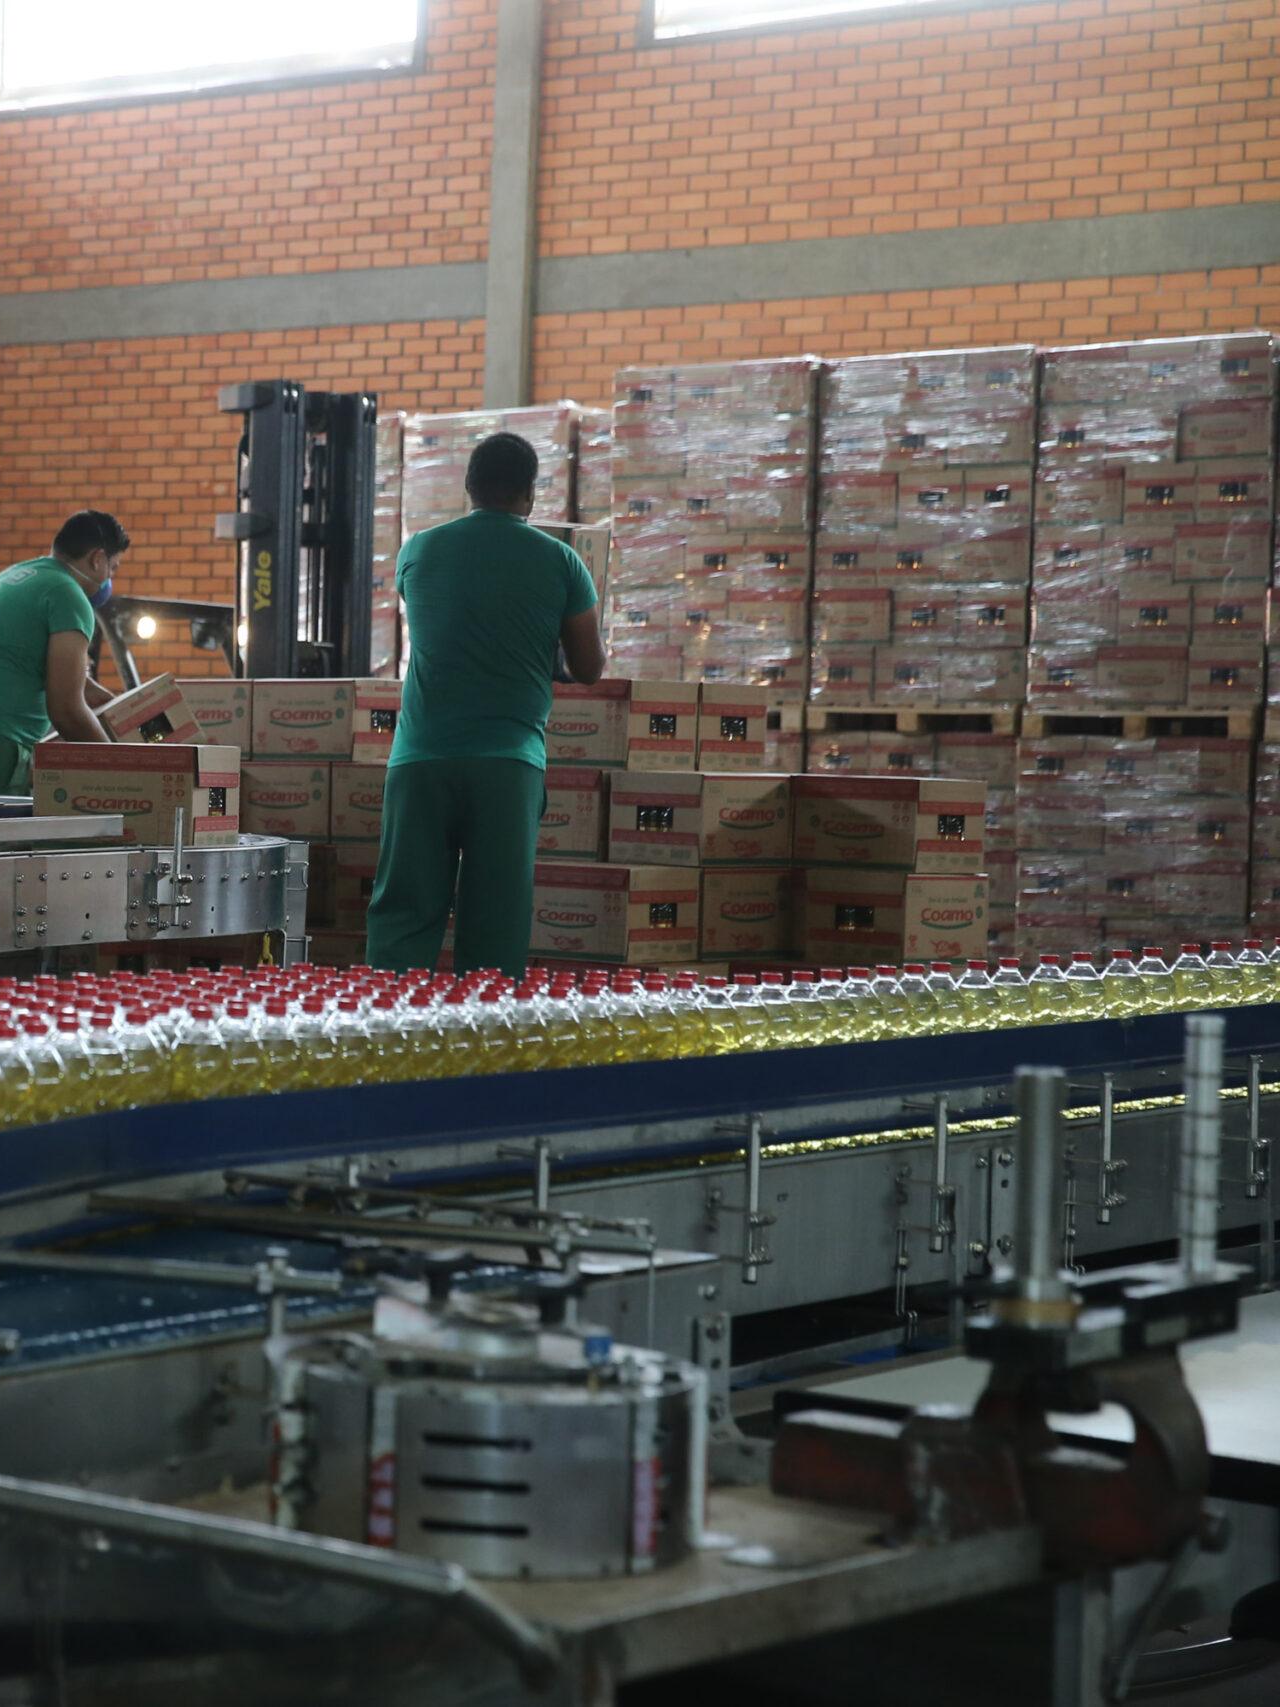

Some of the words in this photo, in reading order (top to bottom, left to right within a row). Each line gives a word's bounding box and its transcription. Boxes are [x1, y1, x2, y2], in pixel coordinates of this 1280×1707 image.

[254, 551, 272, 611] Yale
[194, 709, 233, 720] amo
[270, 708, 333, 721] Coamo
[72, 795, 153, 811] Coamo
[248, 789, 309, 803] Coamo
[719, 807, 776, 821] Coamo
[720, 901, 776, 914] Coamo
[921, 907, 973, 921] Coamo
[537, 908, 597, 922] Coamo
